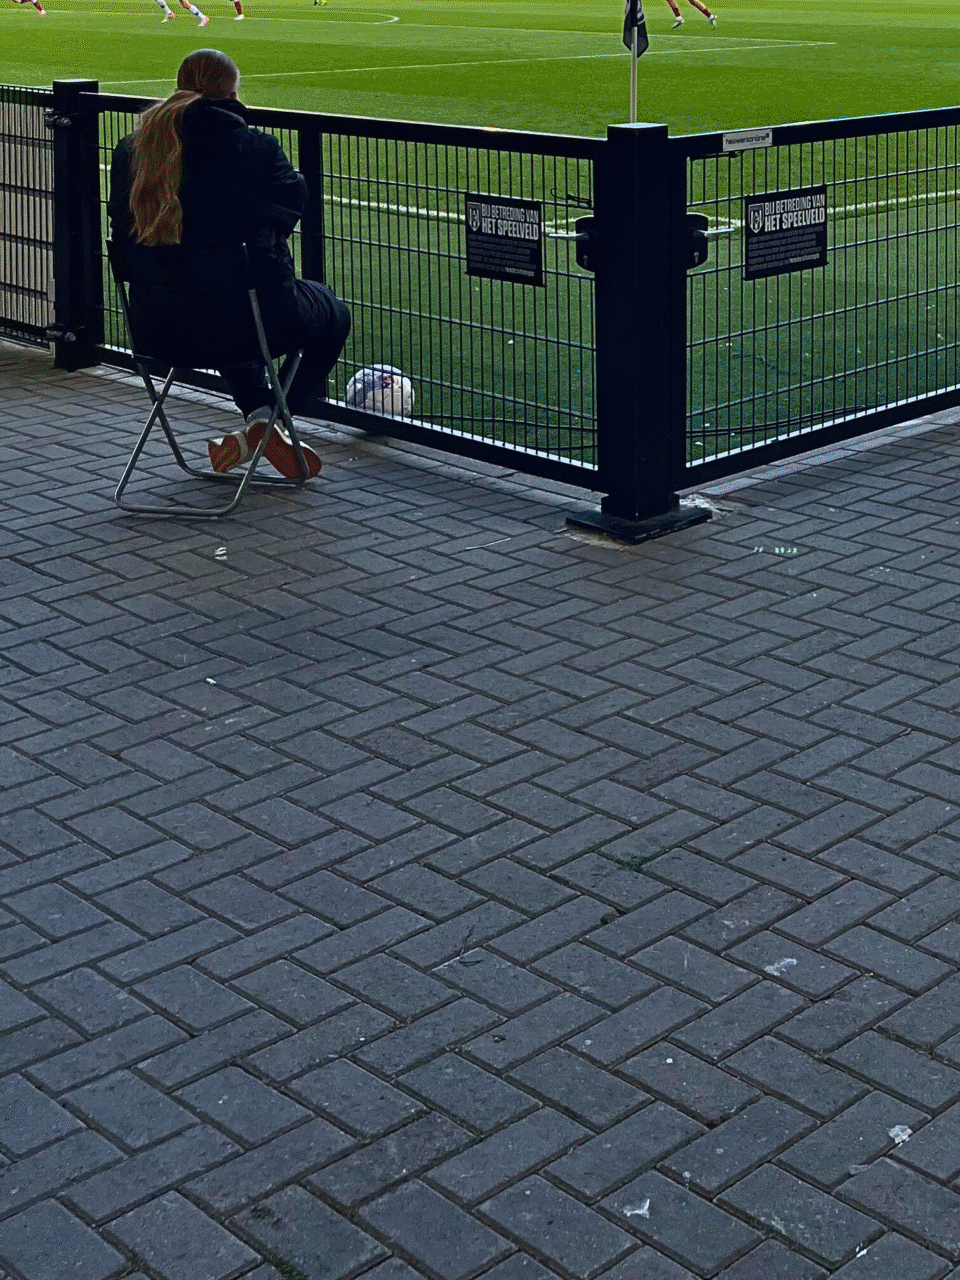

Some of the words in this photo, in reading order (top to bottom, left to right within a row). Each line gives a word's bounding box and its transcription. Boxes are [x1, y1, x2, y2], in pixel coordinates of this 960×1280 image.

[481, 203, 491, 217] BIJ
[491, 205, 525, 222] BETREDING
[525, 209, 539, 224] VAN
[764, 202, 775, 216] BIJ
[775, 195, 812, 214] BETREDING
[812, 194, 826, 208] VAN
[481, 217, 496, 234] HET
[497, 219, 539, 241] SPEELVELD
[764, 214, 781, 233] HET
[782, 207, 826, 230] SPEELVELD
